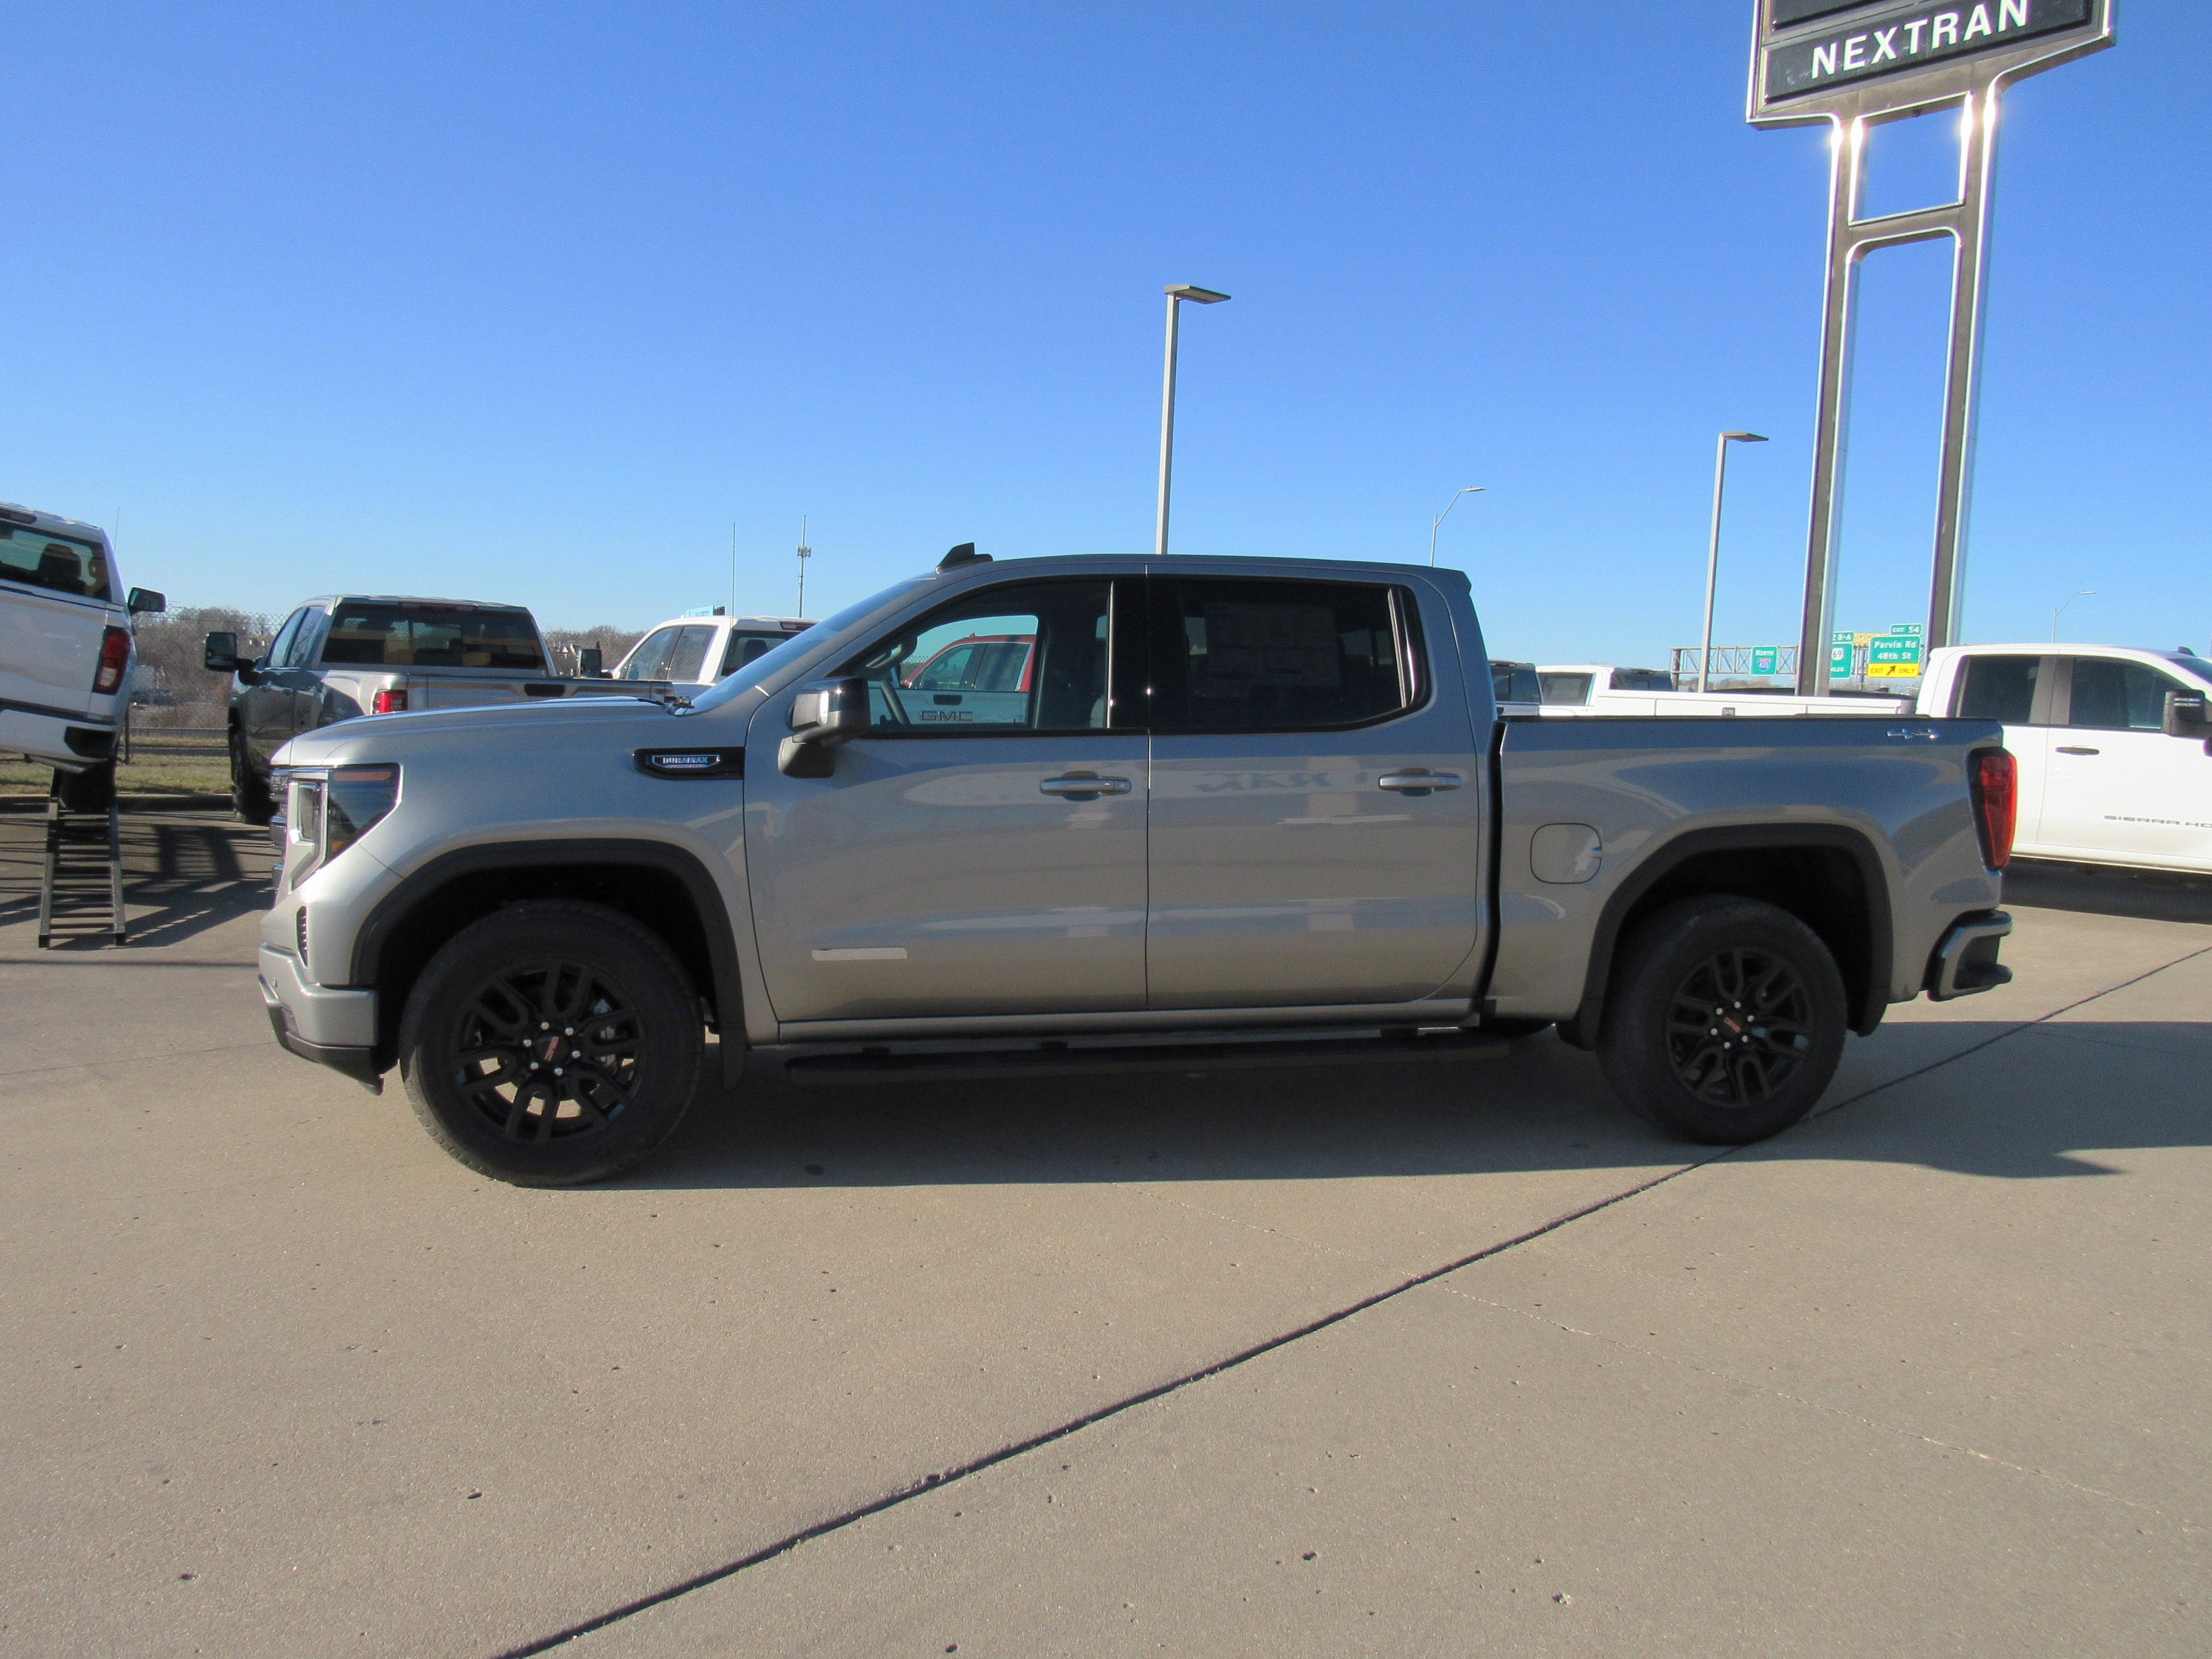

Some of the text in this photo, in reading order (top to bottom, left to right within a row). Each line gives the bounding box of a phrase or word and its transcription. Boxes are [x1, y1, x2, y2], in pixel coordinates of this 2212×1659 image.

[1811, 0, 2028, 79] NEXTRAN
[920, 711, 973, 721] GMC
[2104, 815, 2180, 825] SIERRA
